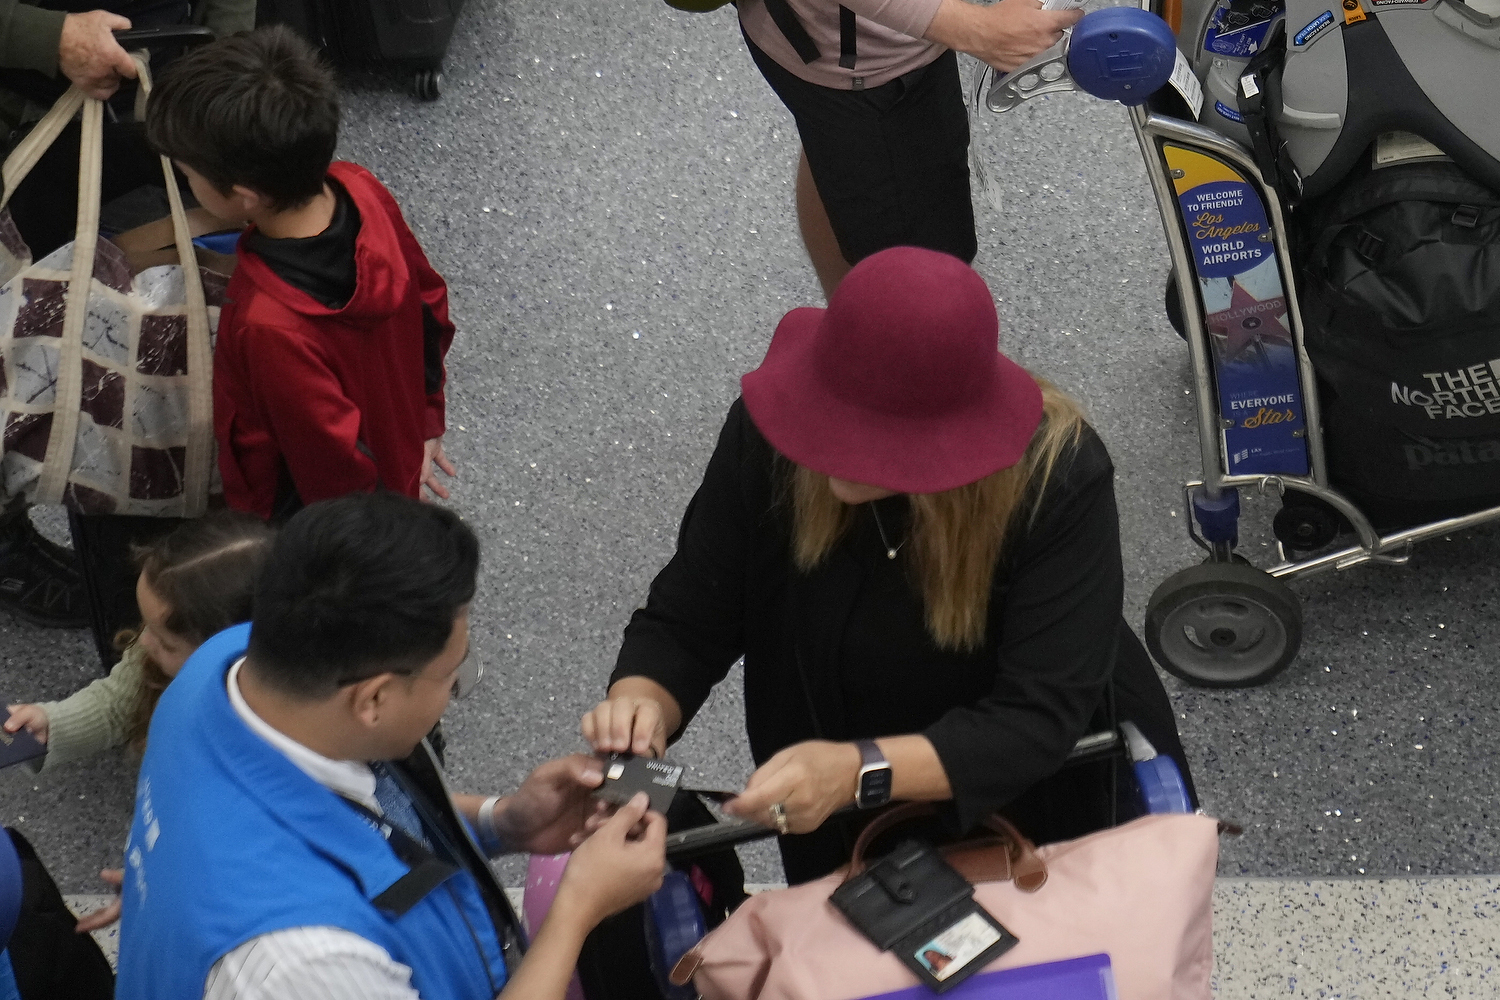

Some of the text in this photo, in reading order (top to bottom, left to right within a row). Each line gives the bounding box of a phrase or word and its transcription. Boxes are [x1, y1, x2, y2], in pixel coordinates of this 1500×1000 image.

[1305, 20, 1330, 40] REAR-FACING
[1307, 21, 1319, 31] LATCH
[1196, 190, 1243, 202] WELCOME
[1187, 198, 1244, 212] TO FRIENDLY
[1192, 212, 1224, 228] Los
[1196, 221, 1260, 240] Angeles
[1202, 241, 1244, 254] WORLD
[1203, 249, 1262, 265] AIRPORTS
[1212, 299, 1283, 324] HOLLYWOOD
[1423, 363, 1492, 392] THE
[1231, 394, 1294, 410] EVERYONE
[1391, 381, 1500, 407] NORTH
[1241, 407, 1296, 428] Star
